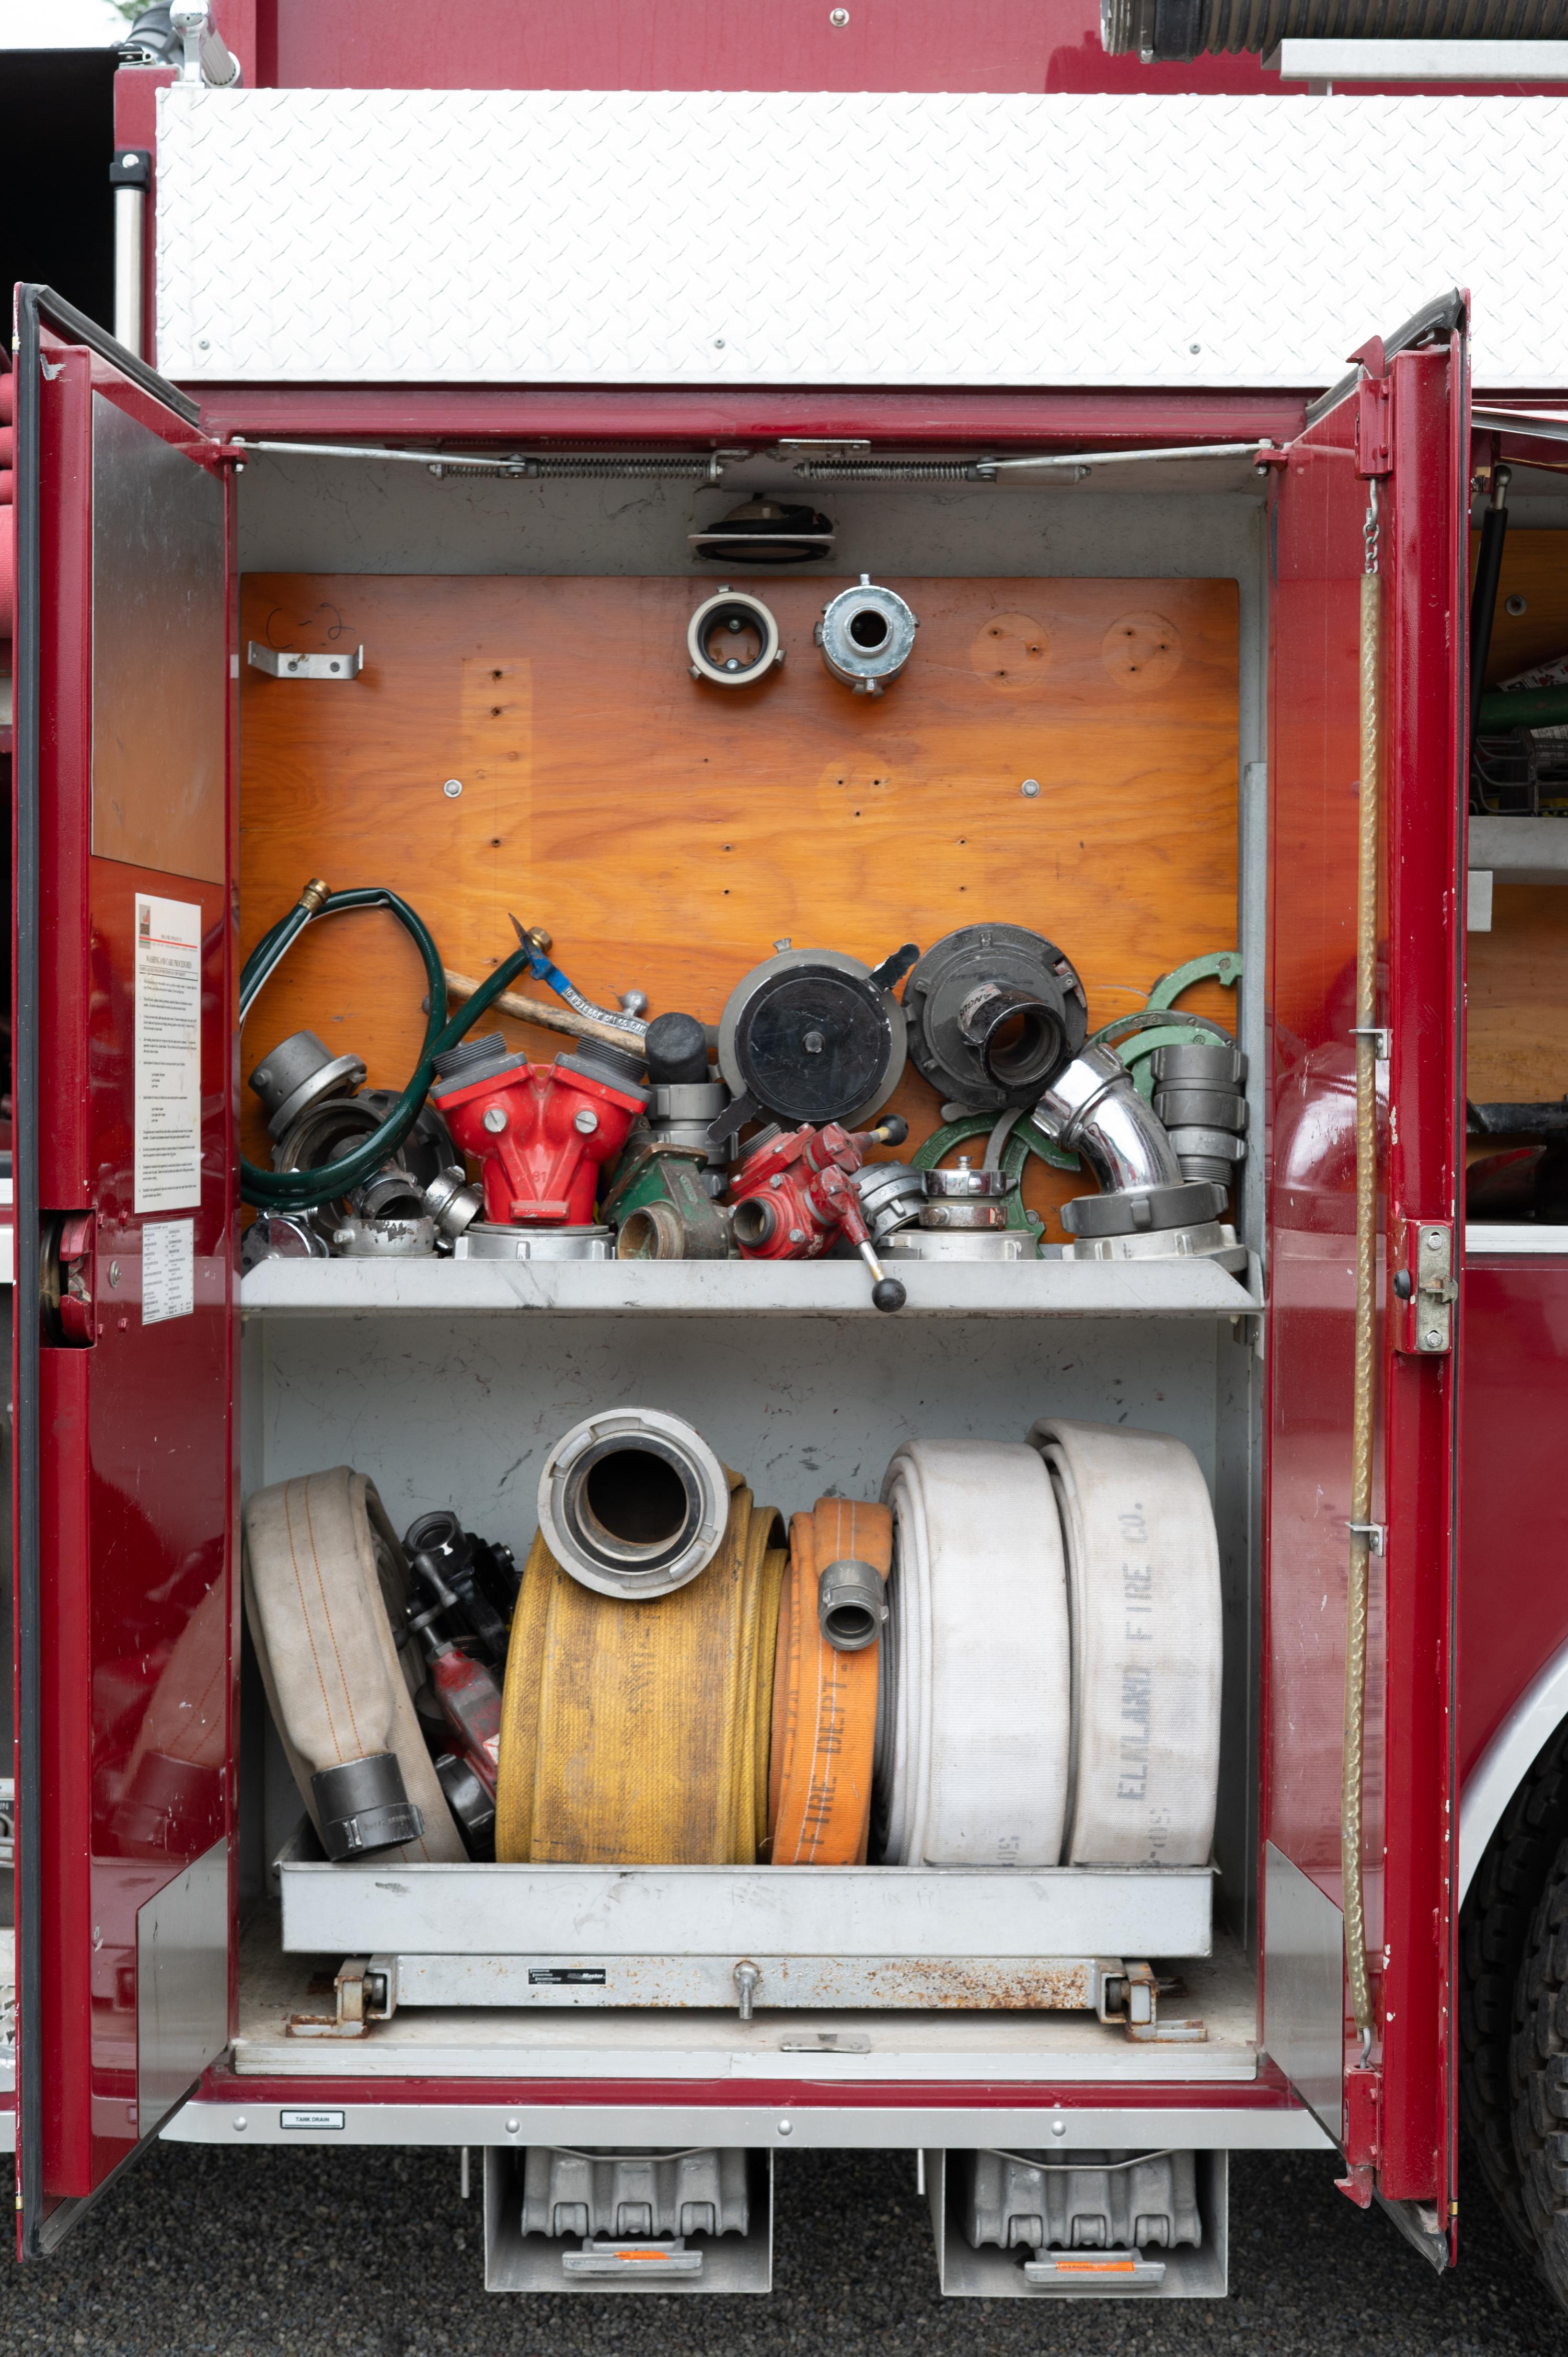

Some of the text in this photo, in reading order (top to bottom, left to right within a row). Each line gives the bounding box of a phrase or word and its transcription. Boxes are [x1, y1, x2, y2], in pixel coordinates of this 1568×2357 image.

[1001, 929, 1043, 949] ANGUS
[1124, 1563, 1152, 1640] FIRE
[801, 1774, 837, 1845] FIRE
